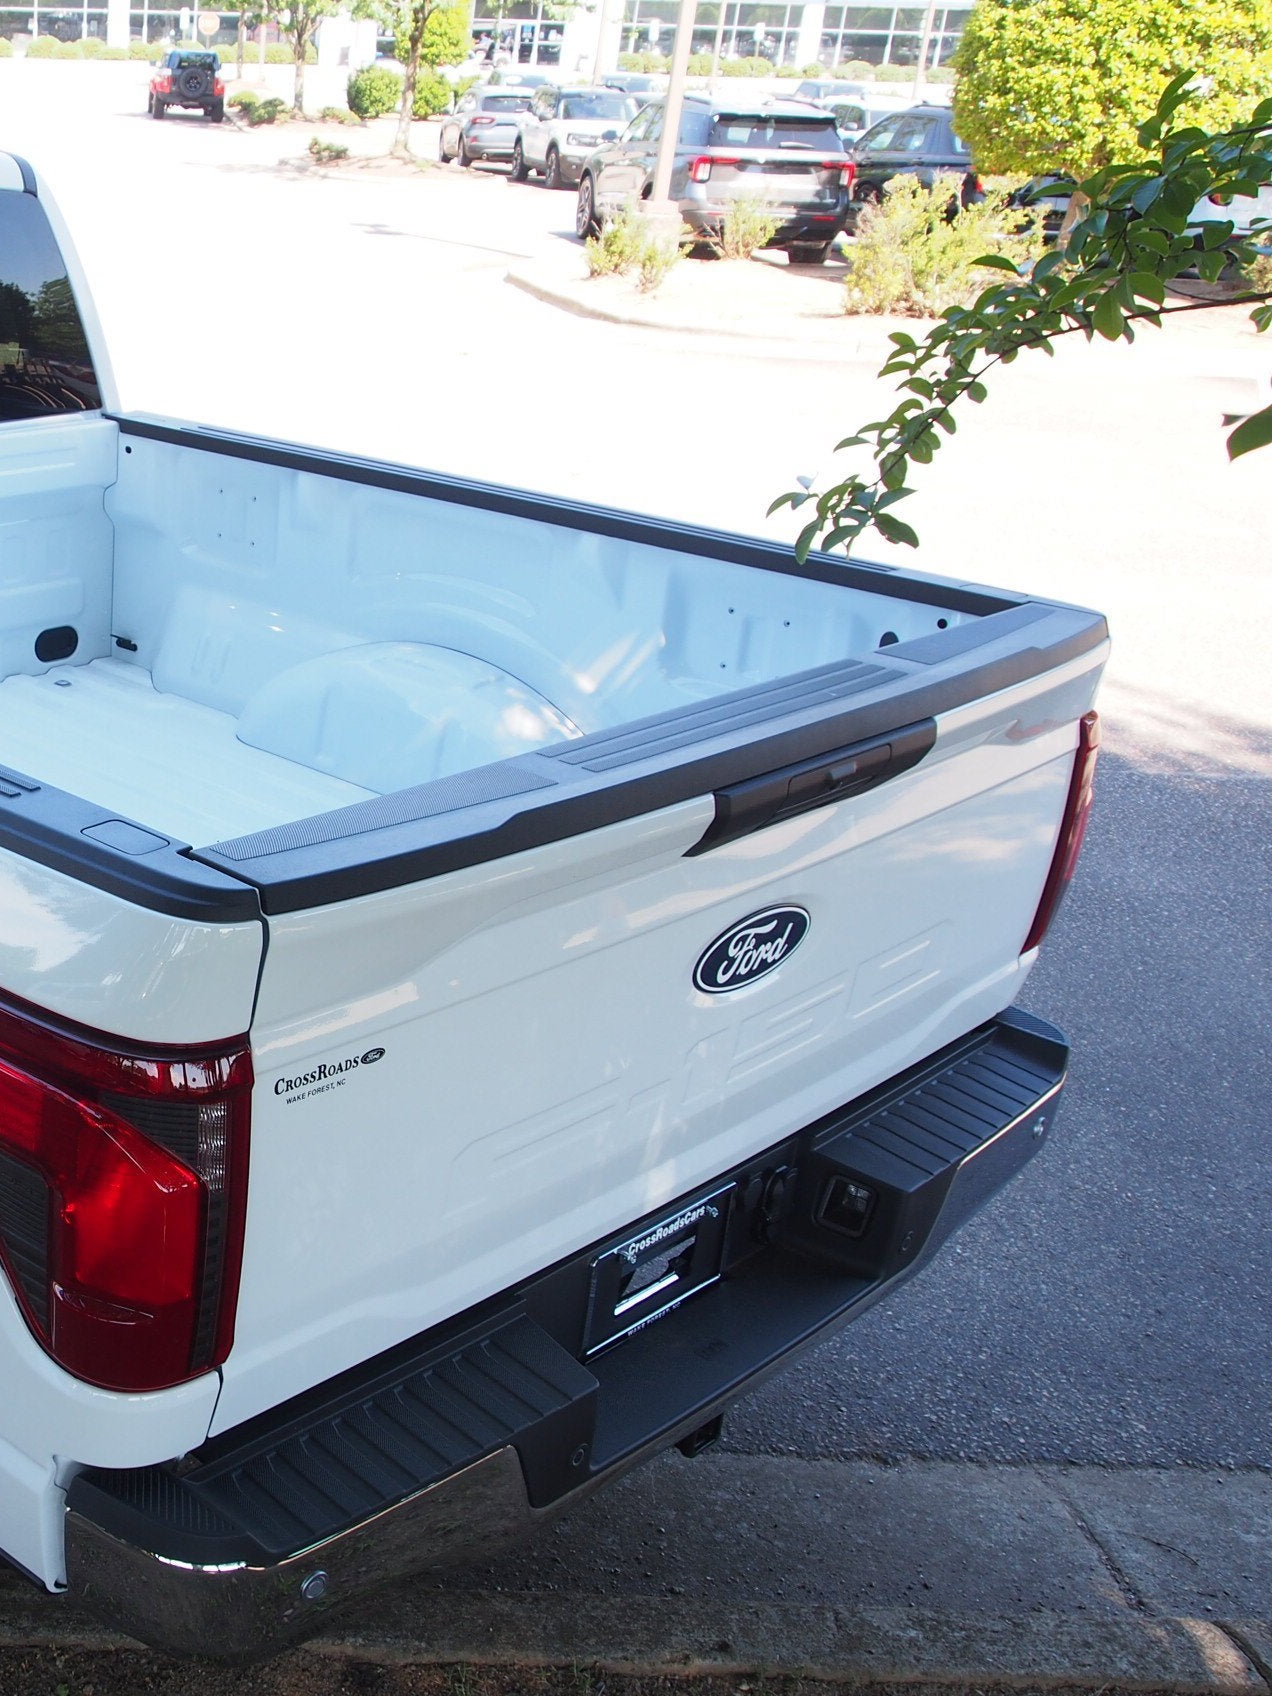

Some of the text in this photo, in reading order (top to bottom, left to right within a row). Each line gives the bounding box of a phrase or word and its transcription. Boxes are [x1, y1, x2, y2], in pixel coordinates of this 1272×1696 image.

[716, 919, 794, 984] Ford
[286, 1092, 306, 1105] WAKE
[336, 1078, 346, 1086] NC
[628, 1205, 706, 1255] CrossRoadsCars
